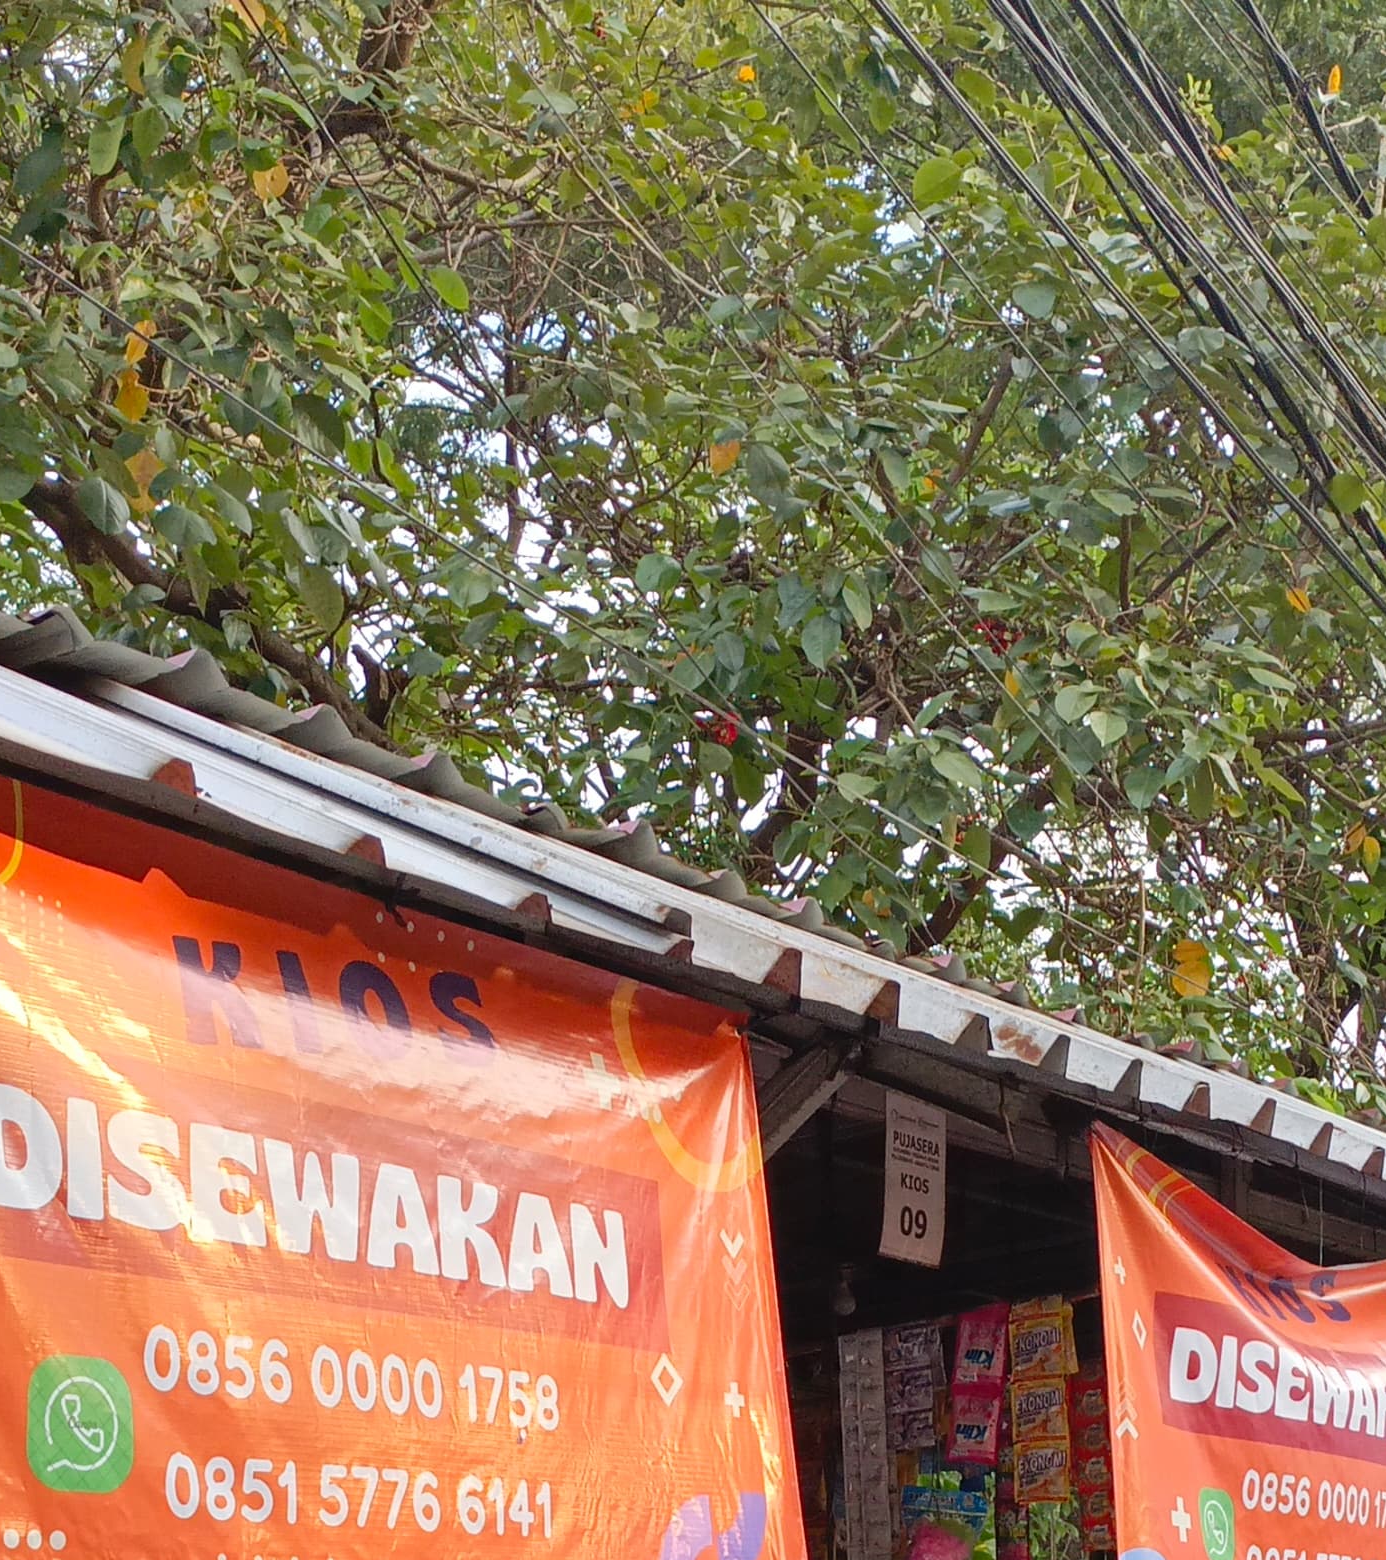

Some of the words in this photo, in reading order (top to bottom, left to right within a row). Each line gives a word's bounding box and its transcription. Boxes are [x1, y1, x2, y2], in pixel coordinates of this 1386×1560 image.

[172, 935, 499, 1066] KIOS
[893, 1130, 940, 1157] PUJASERA
[900, 1172, 929, 1195] KIOS
[900, 1206, 927, 1239] 09
[143, 1324, 293, 1403] 0856
[311, 1345, 443, 1419] 0000
[459, 1363, 560, 1431] 1758
[165, 1452, 298, 1525] 0851
[319, 1464, 441, 1532] 5776
[458, 1474, 552, 1538] 6141
[1242, 1469, 1311, 1517] 0856
[1318, 1480, 1370, 1526] 0000
